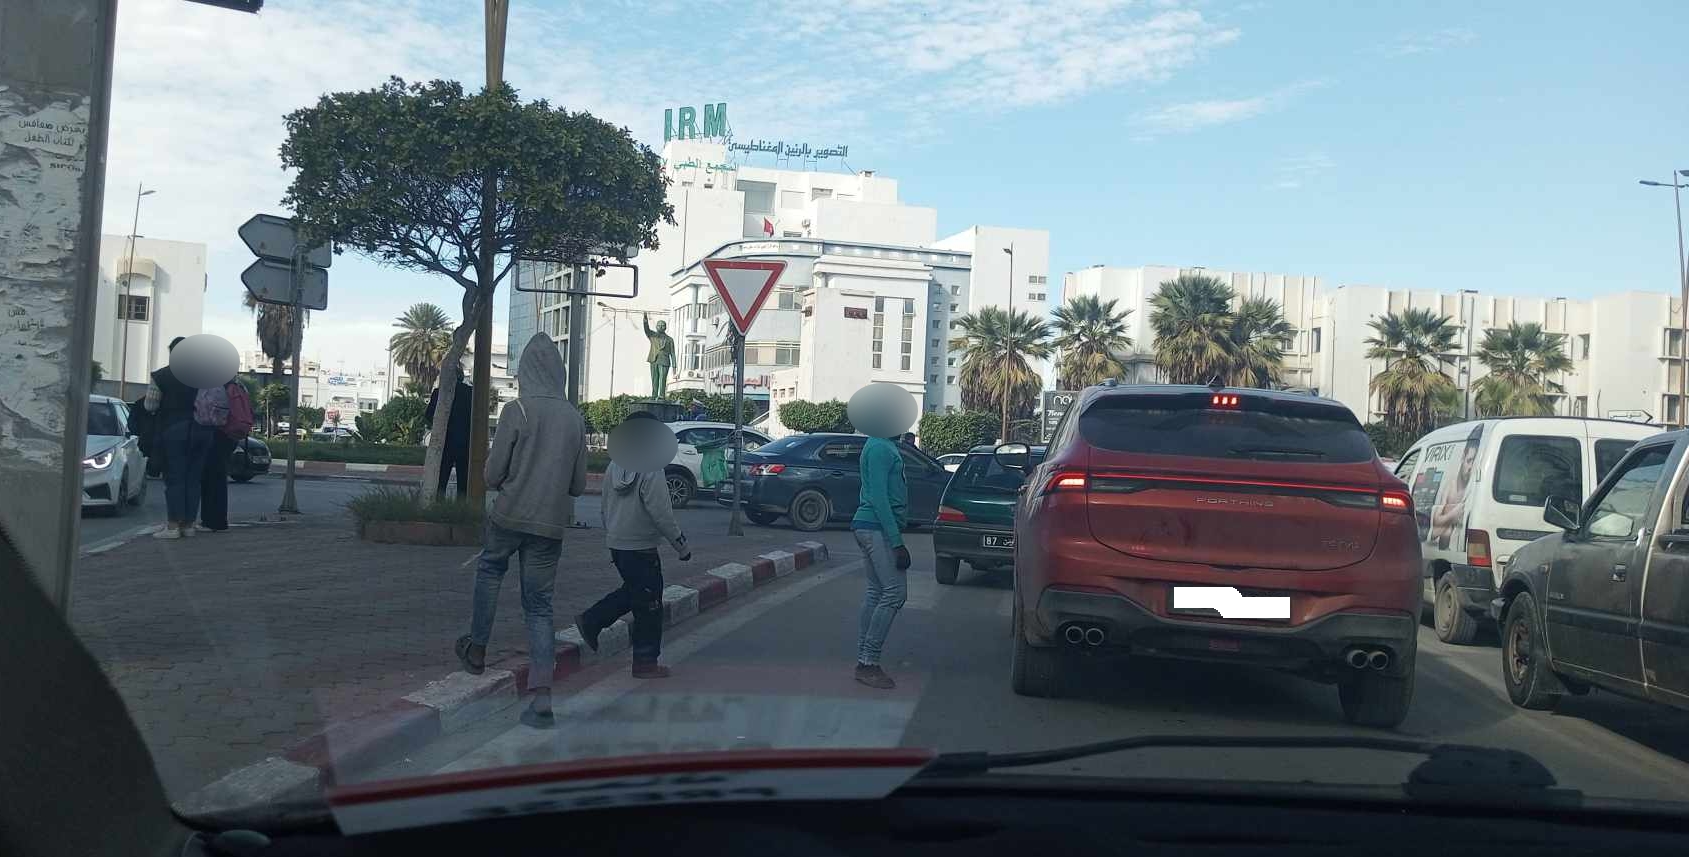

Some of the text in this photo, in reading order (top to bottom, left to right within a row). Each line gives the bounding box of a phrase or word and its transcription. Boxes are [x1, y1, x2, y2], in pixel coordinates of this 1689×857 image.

[664, 102, 727, 142] IRM
[785, 143, 811, 157] بالرنين
[813, 145, 848, 158] التصوير
[986, 536, 998, 546] 87
